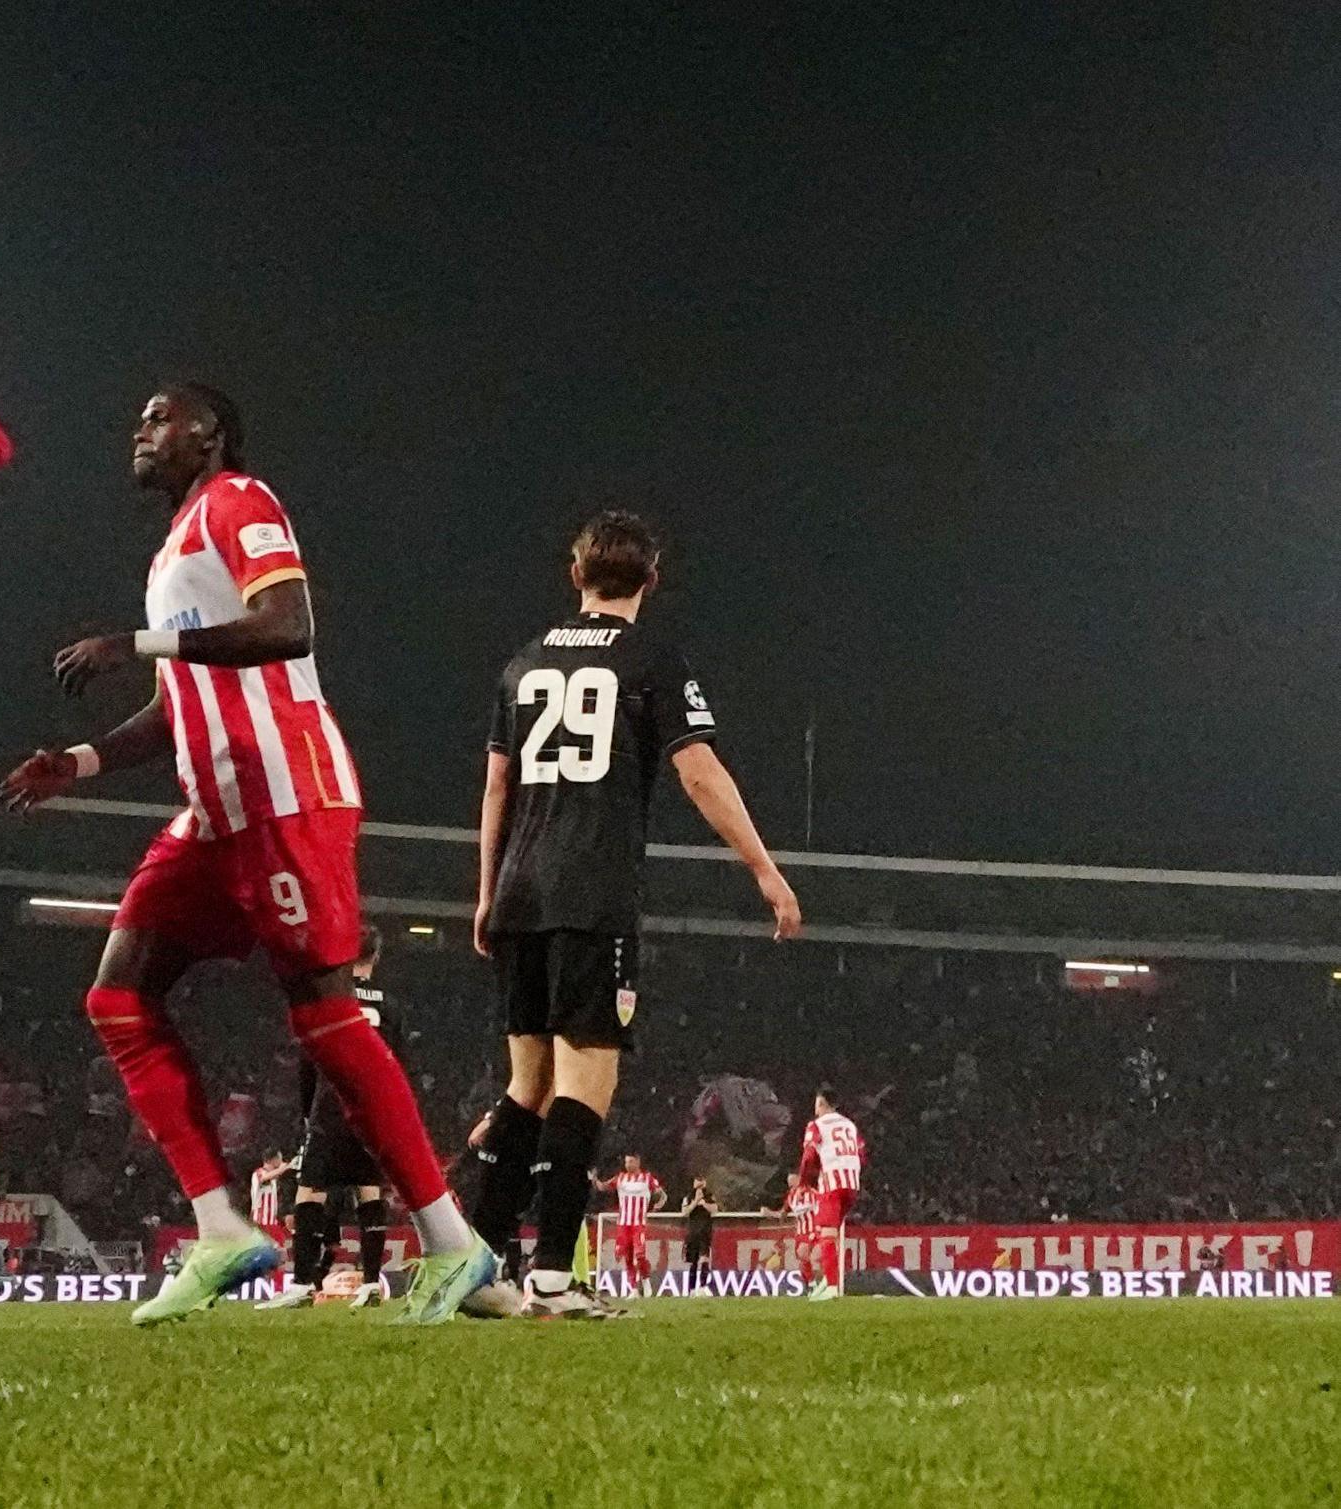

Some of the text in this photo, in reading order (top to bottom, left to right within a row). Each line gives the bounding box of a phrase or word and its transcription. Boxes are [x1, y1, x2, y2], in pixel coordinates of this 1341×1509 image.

[542, 628, 622, 647] ROUAULT
[517, 667, 619, 785] 29
[269, 871, 309, 926] 9
[355, 987, 384, 1001] TILLER
[831, 1127, 857, 1156] 55
[57, 1274, 146, 1301] BEST
[658, 1269, 804, 1297] AIRWAYS
[931, 1270, 1333, 1298] WORLD'S BEST AIRLINE
